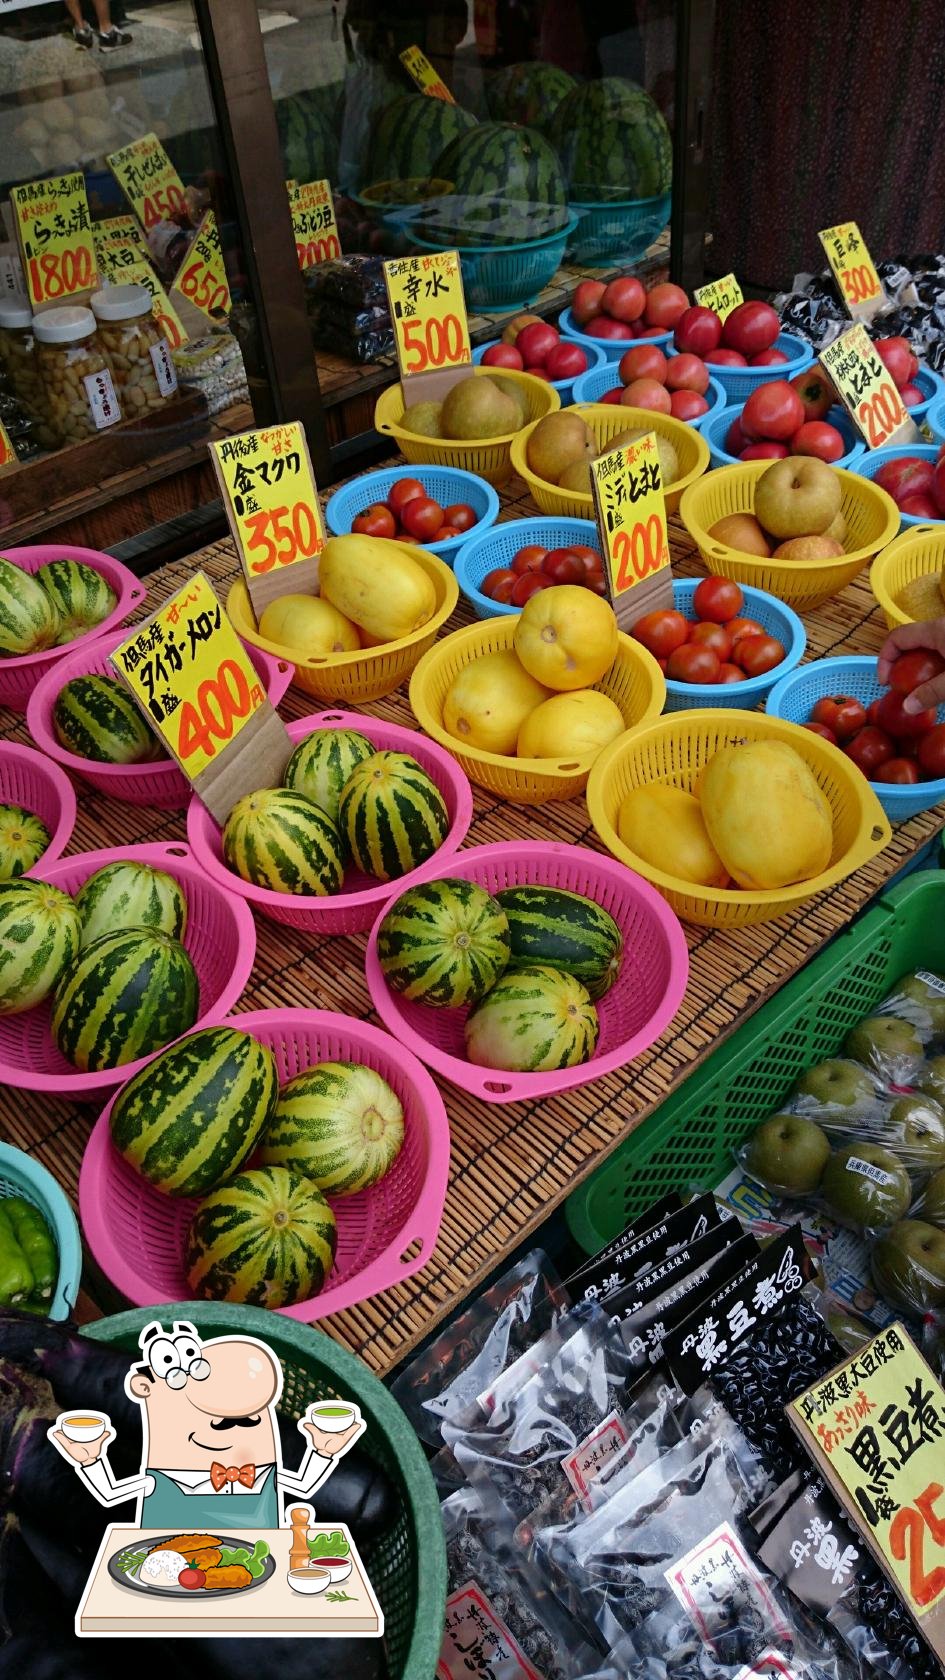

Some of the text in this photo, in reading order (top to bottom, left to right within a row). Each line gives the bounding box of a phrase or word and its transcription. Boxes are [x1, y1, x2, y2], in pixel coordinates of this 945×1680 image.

[402, 271, 450, 303] 幸水
[849, 356, 883, 394] とまと
[233, 452, 301, 496] 金マクワ
[605, 460, 661, 511] ミディとまと
[120, 620, 165, 673] 但馬産
[803, 1328, 906, 1424] 丹波黒大豆使用
[817, 1389, 877, 1453] あっさり味
[844, 1377, 945, 1494] 黒豆煮
